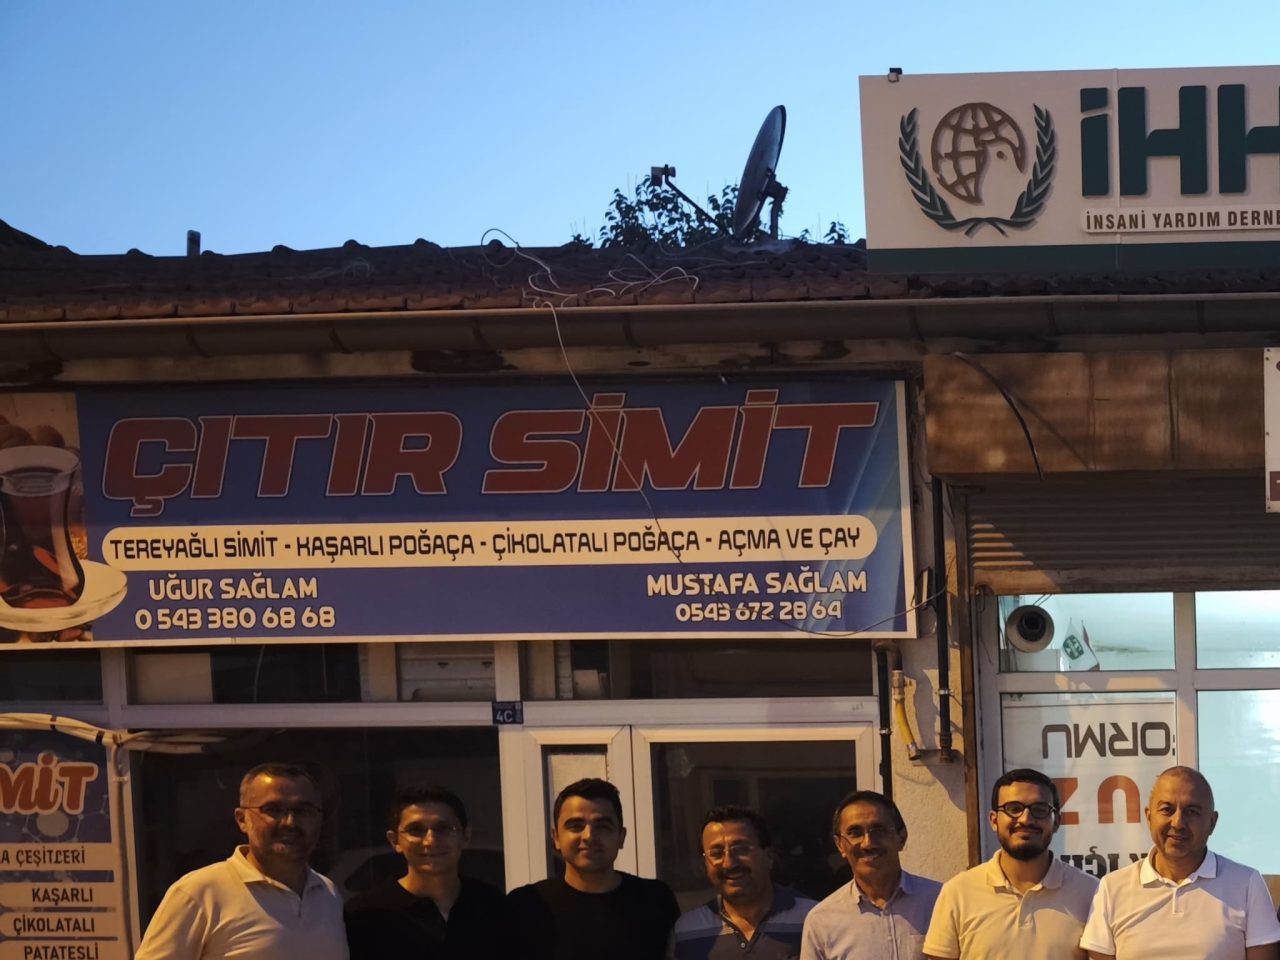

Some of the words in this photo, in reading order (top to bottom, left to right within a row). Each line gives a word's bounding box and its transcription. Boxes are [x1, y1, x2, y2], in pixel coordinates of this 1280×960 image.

[1086, 208, 1147, 231] İNSANİ
[1152, 209, 1221, 229] YARDIM
[102, 411, 463, 517] ÇITIR
[481, 389, 879, 493] SİMİT
[109, 531, 219, 560] TEREYAĞLI
[224, 530, 278, 558] SİMİT
[297, 534, 383, 563] KAŞARLI
[389, 528, 475, 563] POĞAÇA
[493, 527, 607, 561] ÇİKOLATALI
[614, 526, 700, 558] POĞAÇA
[718, 527, 781, 557] AÇMA
[786, 528, 813, 548] VE
[819, 526, 860, 559] ÇAY
[149, 572, 214, 601] UĞUR
[219, 571, 318, 600] SAĞLAM
[646, 571, 759, 597] MUSTAFA
[765, 565, 867, 594] SAĞLAM
[134, 609, 151, 630] 0
[157, 608, 202, 630] 543
[207, 607, 256, 629] 380
[262, 607, 296, 629] 68
[301, 606, 336, 629] 68
[675, 602, 730, 622] 0543
[735, 600, 774, 621] 672
[779, 600, 807, 620] 28
[811, 599, 841, 620] 64
[496, 710, 513, 723] 4C
[16, 846, 85, 867] ÇEŞİTLERİ
[32, 888, 93, 905] KAŞARLI
[13, 914, 95, 936] ÇİKOLATALI
[24, 942, 99, 960] PATATESLİ
